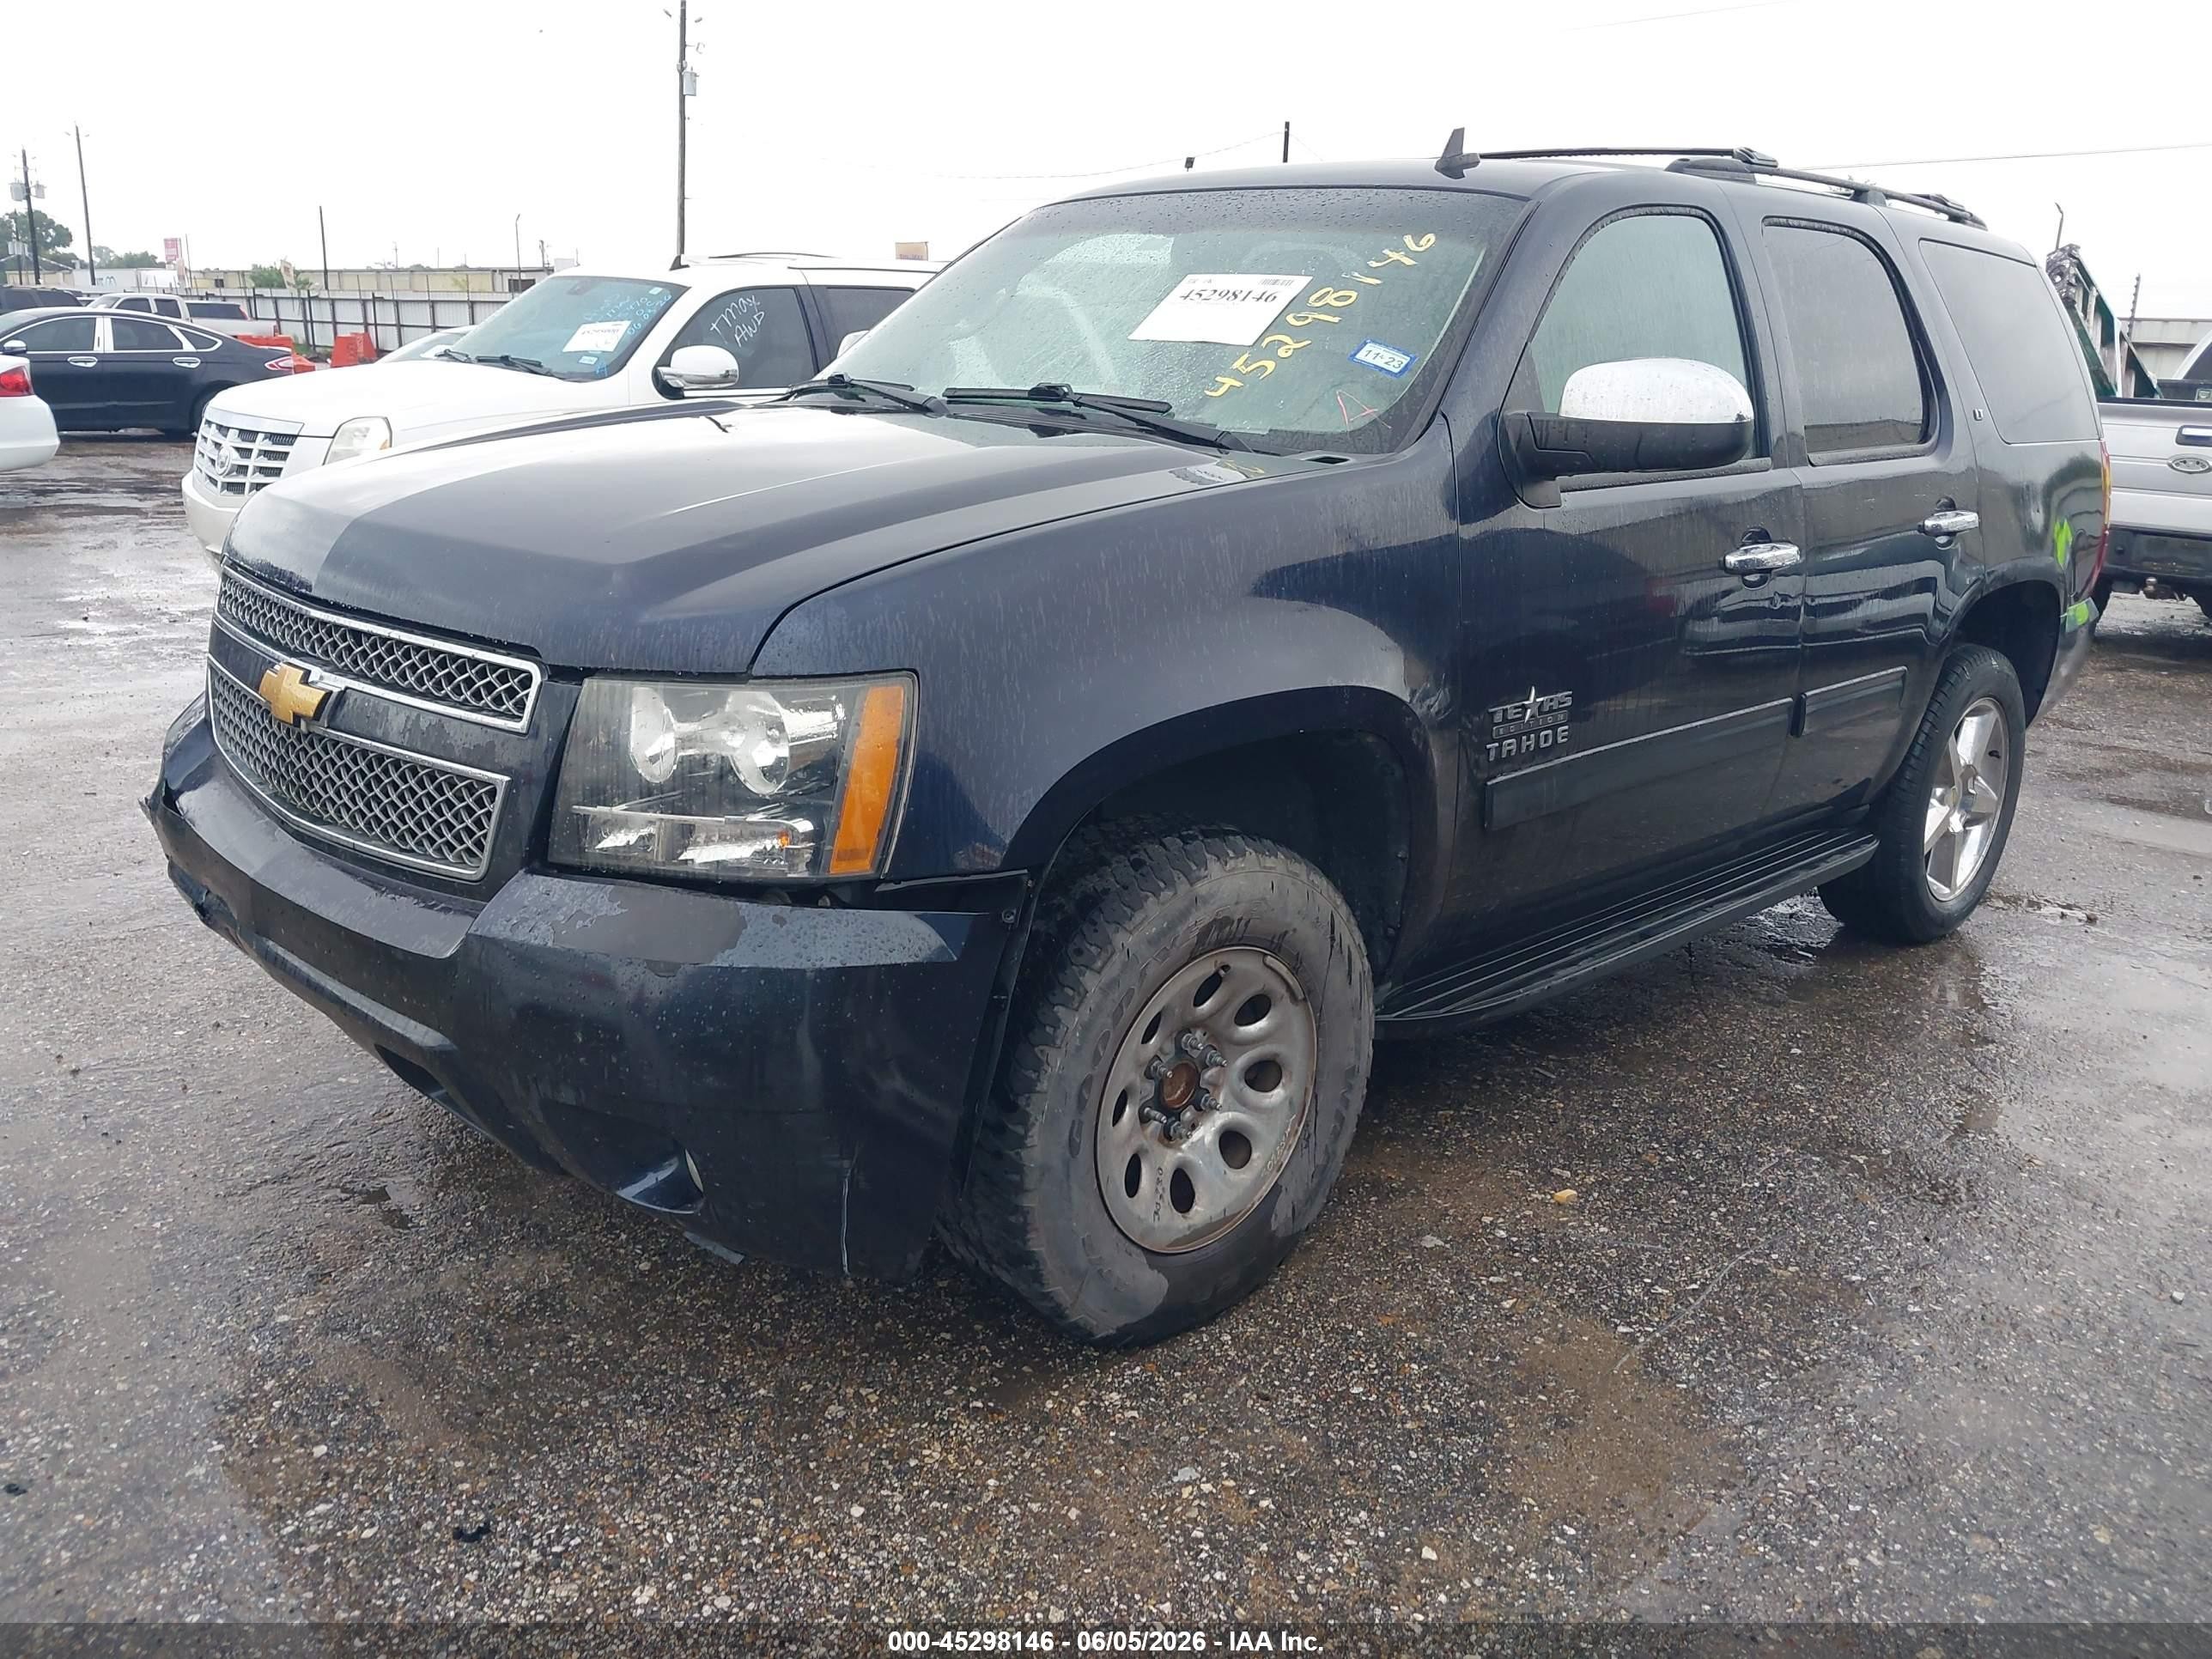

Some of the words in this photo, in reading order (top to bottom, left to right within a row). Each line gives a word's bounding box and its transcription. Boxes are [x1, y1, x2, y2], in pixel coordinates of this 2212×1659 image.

[1179, 289, 1279, 303] 45298146
[1204, 233, 1437, 398] 45298146
[1488, 686, 1573, 724] TEXAS
[1486, 726, 1570, 763] TAHOE
